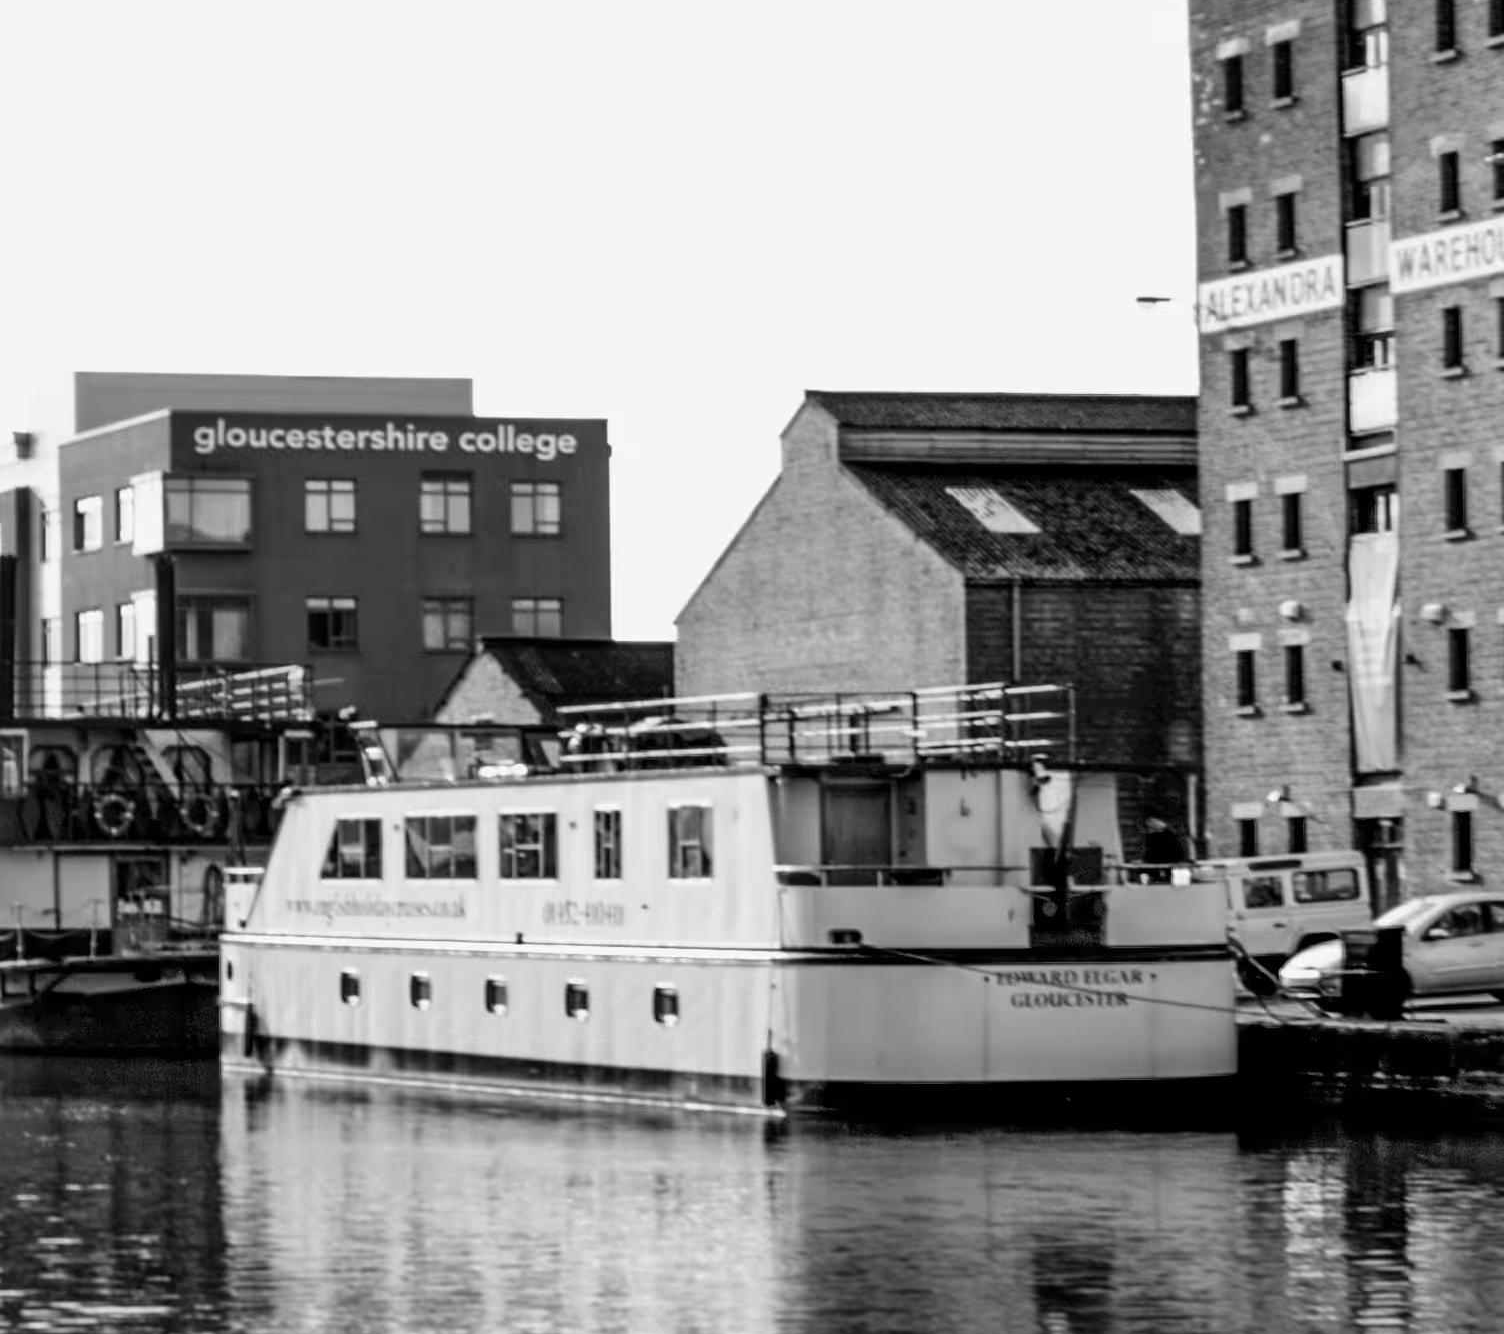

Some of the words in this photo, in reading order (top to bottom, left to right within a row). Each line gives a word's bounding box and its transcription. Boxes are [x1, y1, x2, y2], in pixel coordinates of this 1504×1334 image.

[1205, 266, 1335, 322] ALEXANDRA
[194, 419, 449, 454] gloucestershire
[459, 425, 578, 461] college
[996, 970, 1078, 986] EDWARD
[1084, 969, 1144, 985] ELGAR
[1010, 991, 1129, 1008] GLOUCESTER
